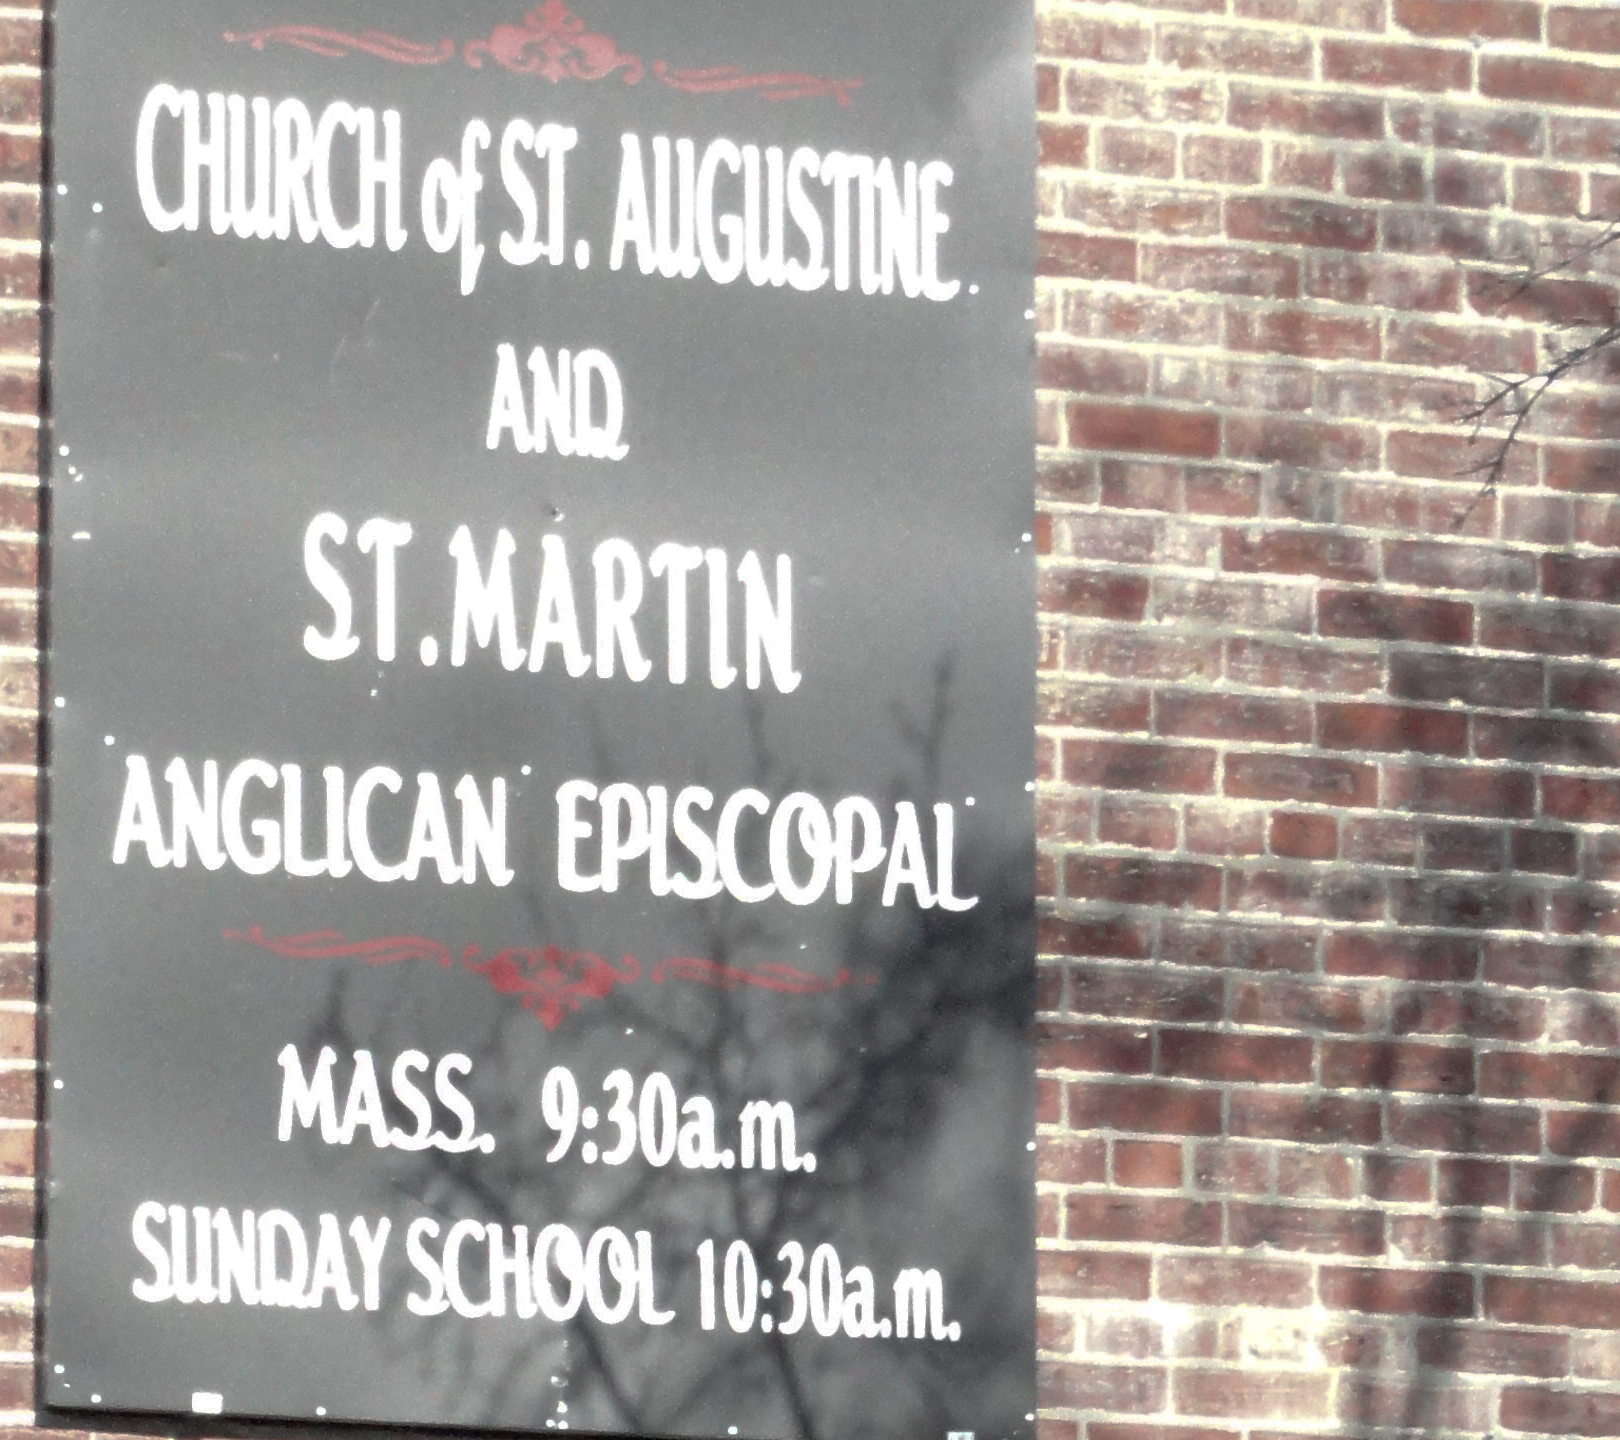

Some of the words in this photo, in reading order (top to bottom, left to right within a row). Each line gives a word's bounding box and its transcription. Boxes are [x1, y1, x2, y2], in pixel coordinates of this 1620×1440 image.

[134, 80, 410, 253] CHURCH
[419, 116, 494, 298] of
[497, 115, 592, 271] ST.
[607, 130, 963, 303] AUGUSTINE
[484, 341, 631, 463] AND
[110, 752, 517, 888] ANGLICAN
[554, 778, 980, 913] EPISCOPAL
[276, 1042, 497, 1155] MASS.
[130, 1199, 393, 1317] SUNDAY
[404, 1215, 677, 1327] SCHOOL
